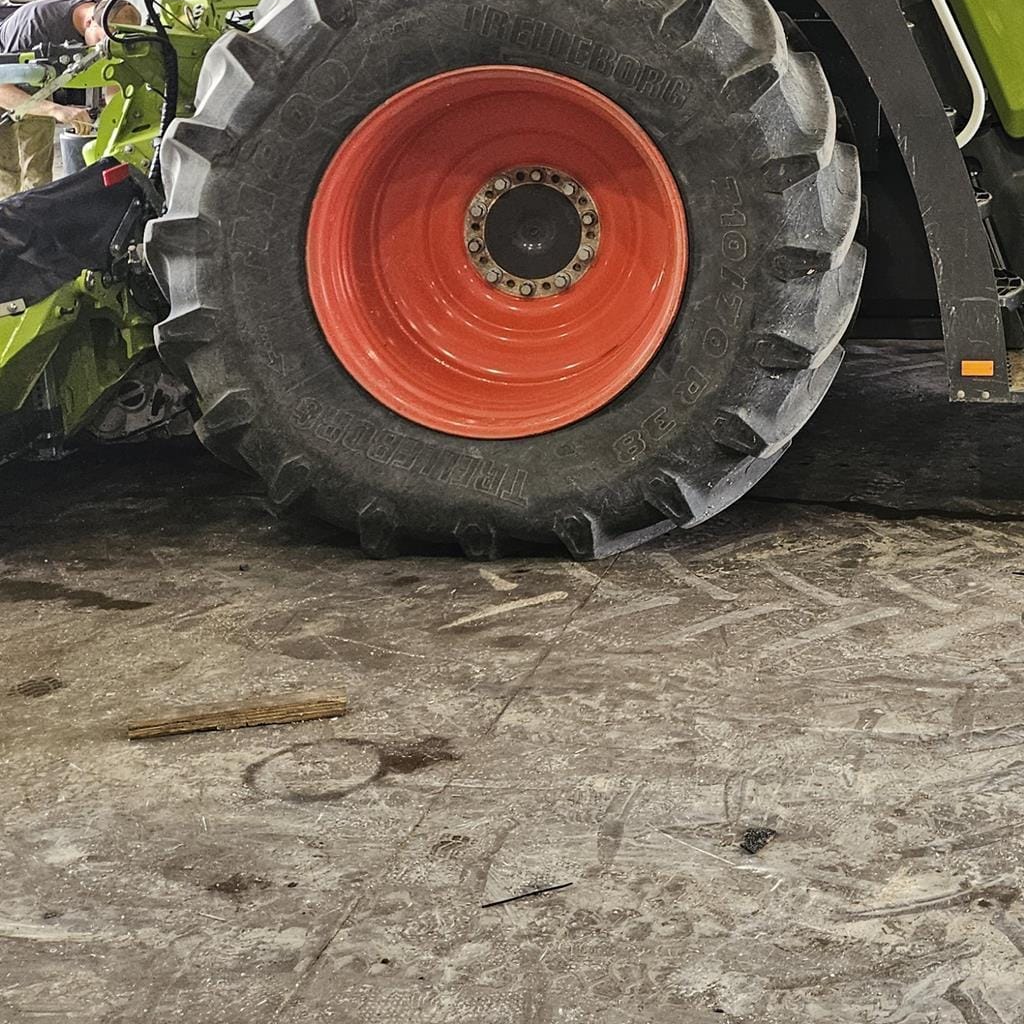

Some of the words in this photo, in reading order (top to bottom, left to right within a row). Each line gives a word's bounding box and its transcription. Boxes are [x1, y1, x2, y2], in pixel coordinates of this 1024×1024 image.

[462, 3, 692, 110] TRELLEBORG
[672, 366, 711, 405] R
[291, 396, 530, 507] TRELLEBORG
[612, 406, 678, 464] 38
